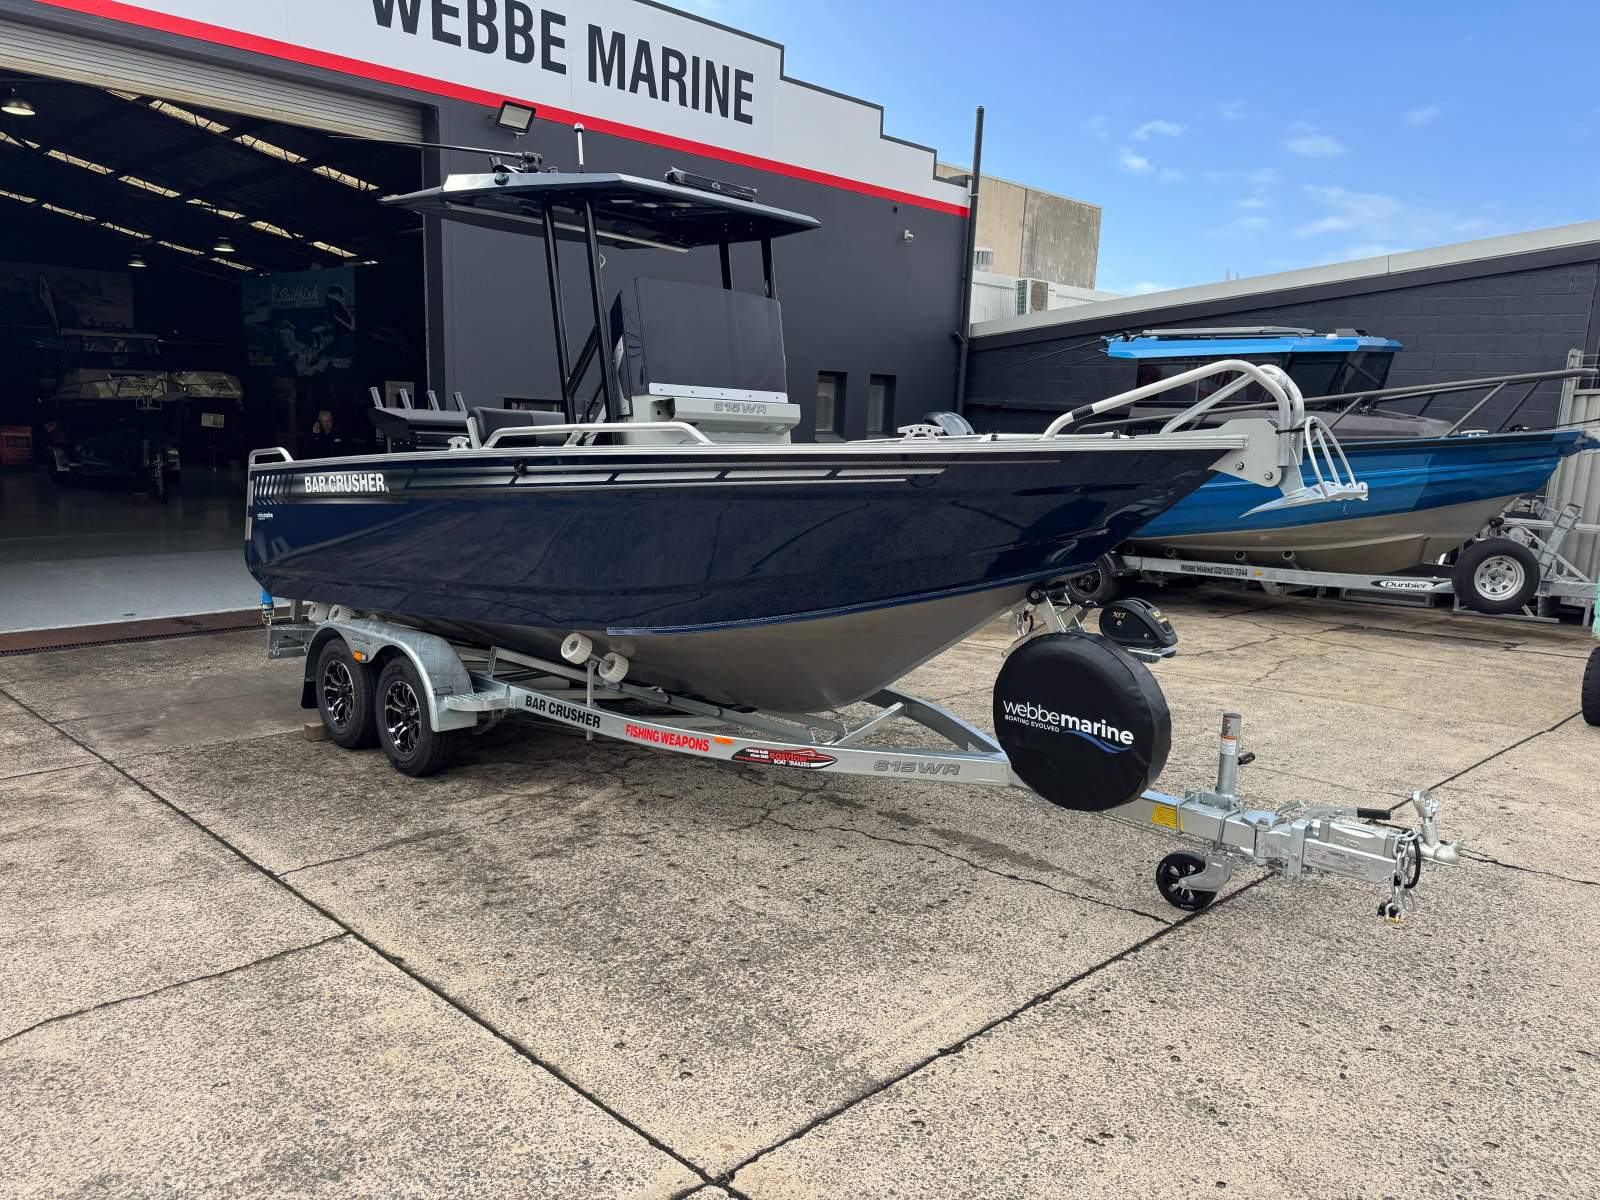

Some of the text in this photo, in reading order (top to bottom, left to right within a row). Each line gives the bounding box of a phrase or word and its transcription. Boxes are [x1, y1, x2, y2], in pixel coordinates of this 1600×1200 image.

[588, 23, 754, 125] MARINE
[1385, 580, 1427, 589] Dunbier
[525, 695, 601, 729] BAR CRUSHER
[1004, 714, 1060, 733] BOATING EVOLVED
[625, 723, 710, 752] FISHING WEAPONS
[873, 760, 961, 775] 615WR
